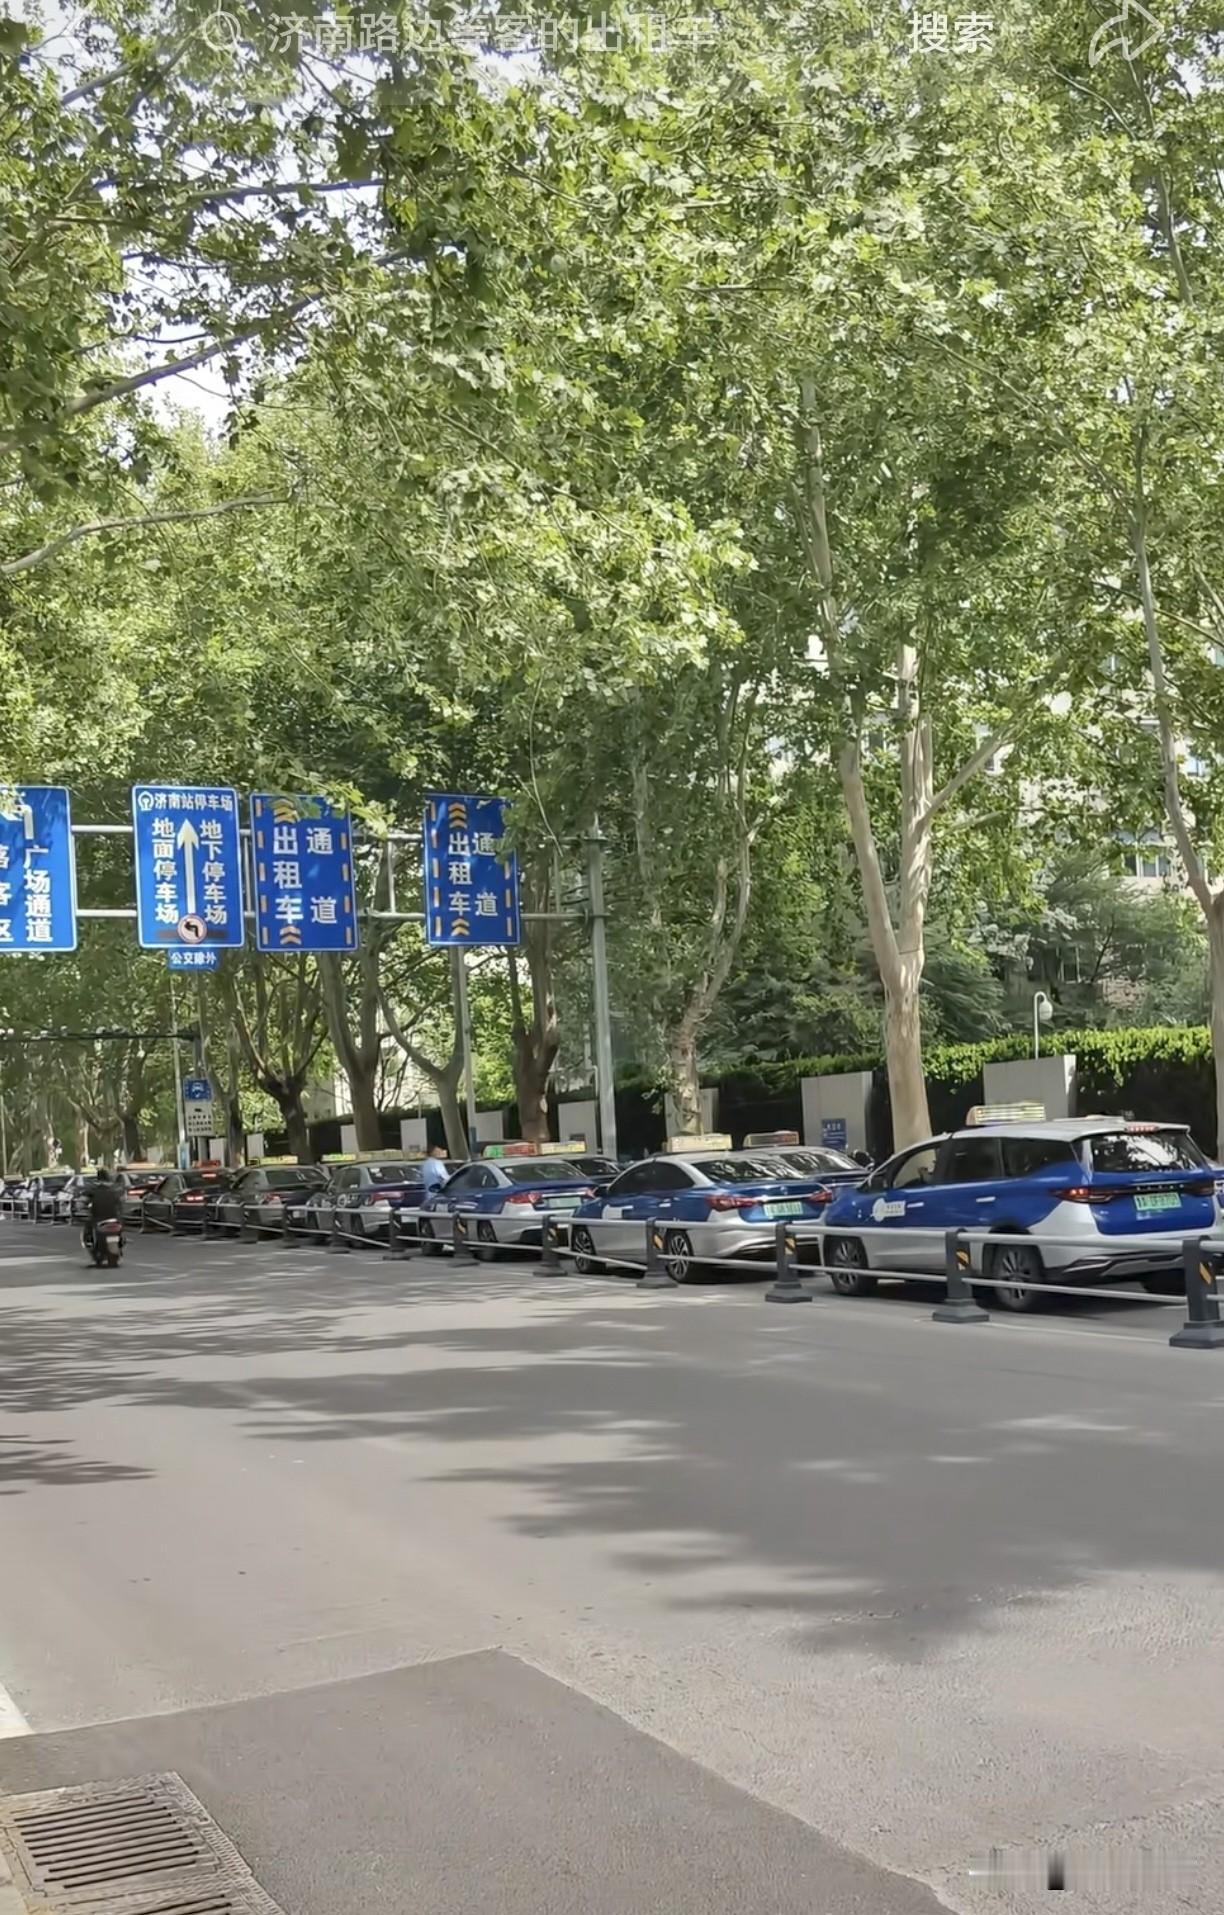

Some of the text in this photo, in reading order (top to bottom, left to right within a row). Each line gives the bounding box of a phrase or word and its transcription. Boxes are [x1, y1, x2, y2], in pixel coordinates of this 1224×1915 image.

[155, 792, 233, 812] 济南站停车场
[23, 845, 53, 943] 广场通道
[152, 817, 180, 924] 地面停车场
[199, 818, 227, 925] 地下停车场
[273, 825, 304, 924] 出租车
[306, 827, 338, 924] 通道
[448, 831, 472, 917] 出租车
[171, 951, 217, 965] 公交除外
